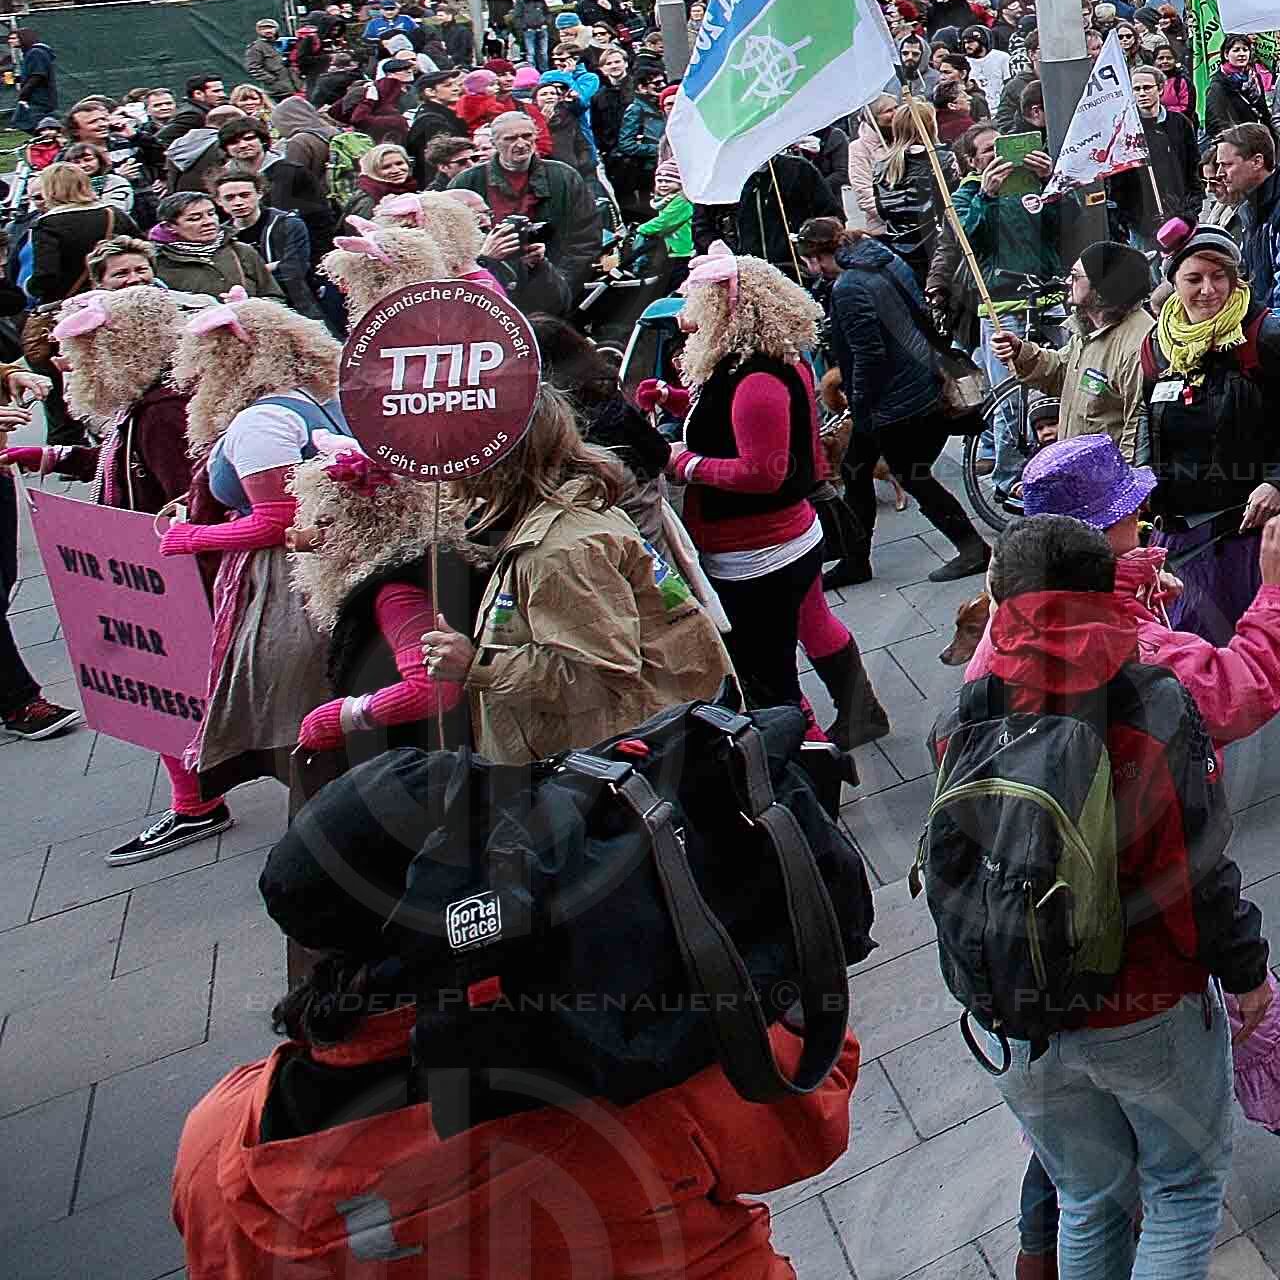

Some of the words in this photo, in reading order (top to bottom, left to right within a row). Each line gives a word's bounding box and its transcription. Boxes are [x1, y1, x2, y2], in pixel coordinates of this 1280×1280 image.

[347, 287, 451, 369] Transatlantische
[454, 287, 530, 359] Partnerschaft
[379, 341, 504, 391] TTIP
[382, 388, 497, 417] STOPPEN
[376, 444, 417, 472] sieht
[482, 431, 509, 457] aus
[55, 544, 104, 581] WIR
[108, 558, 166, 595] SIND
[98, 615, 168, 657] ZWAR
[79, 663, 206, 723] ALLESFRESS
[451, 899, 497, 928] porta
[452, 917, 497, 945] brace
